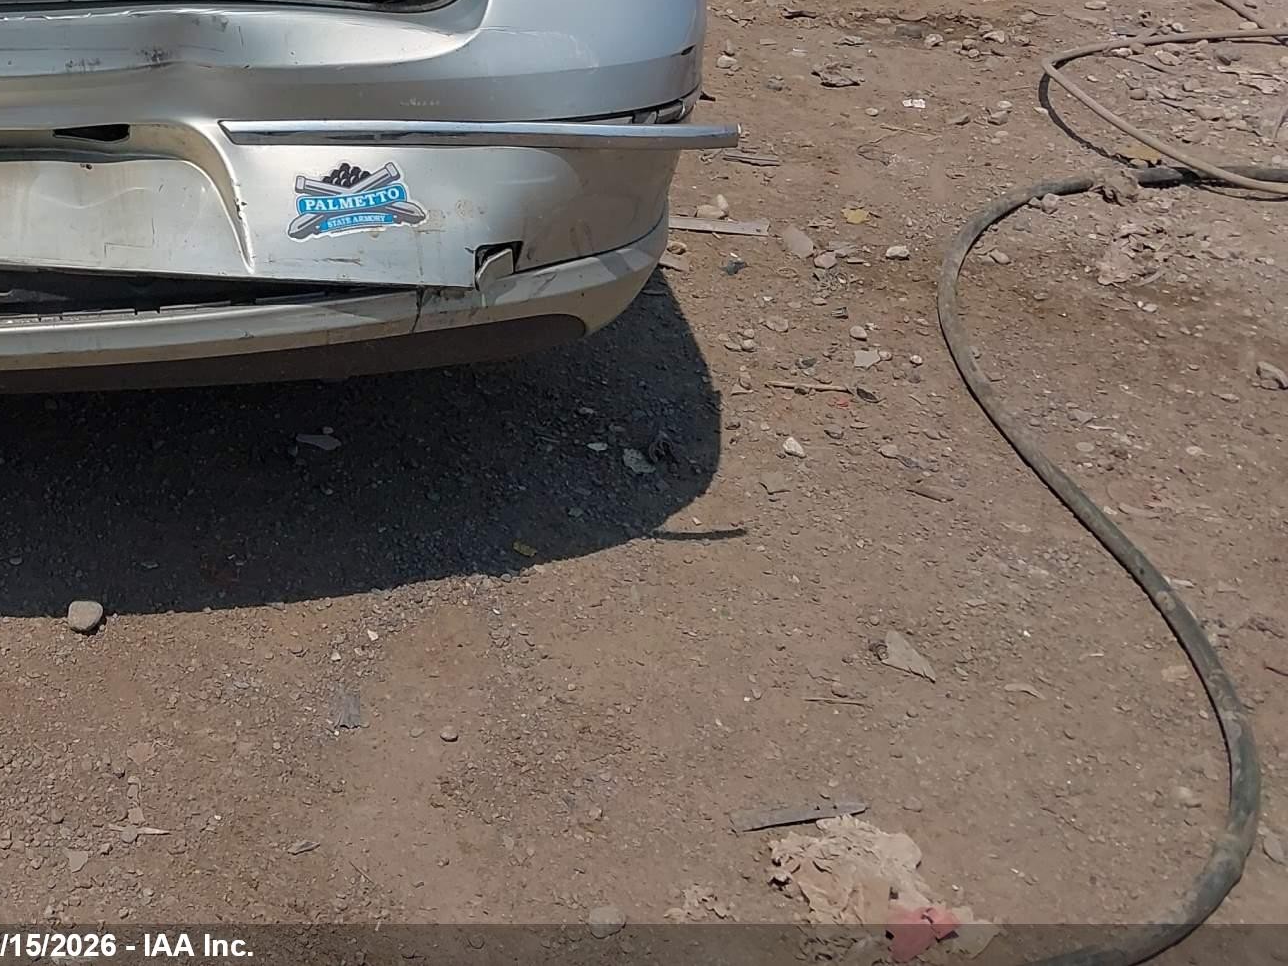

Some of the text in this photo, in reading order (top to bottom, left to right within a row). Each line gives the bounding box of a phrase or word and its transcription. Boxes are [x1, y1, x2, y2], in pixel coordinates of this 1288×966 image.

[304, 188, 400, 211] PALMETTO
[327, 215, 385, 228] STATE ARMORY
